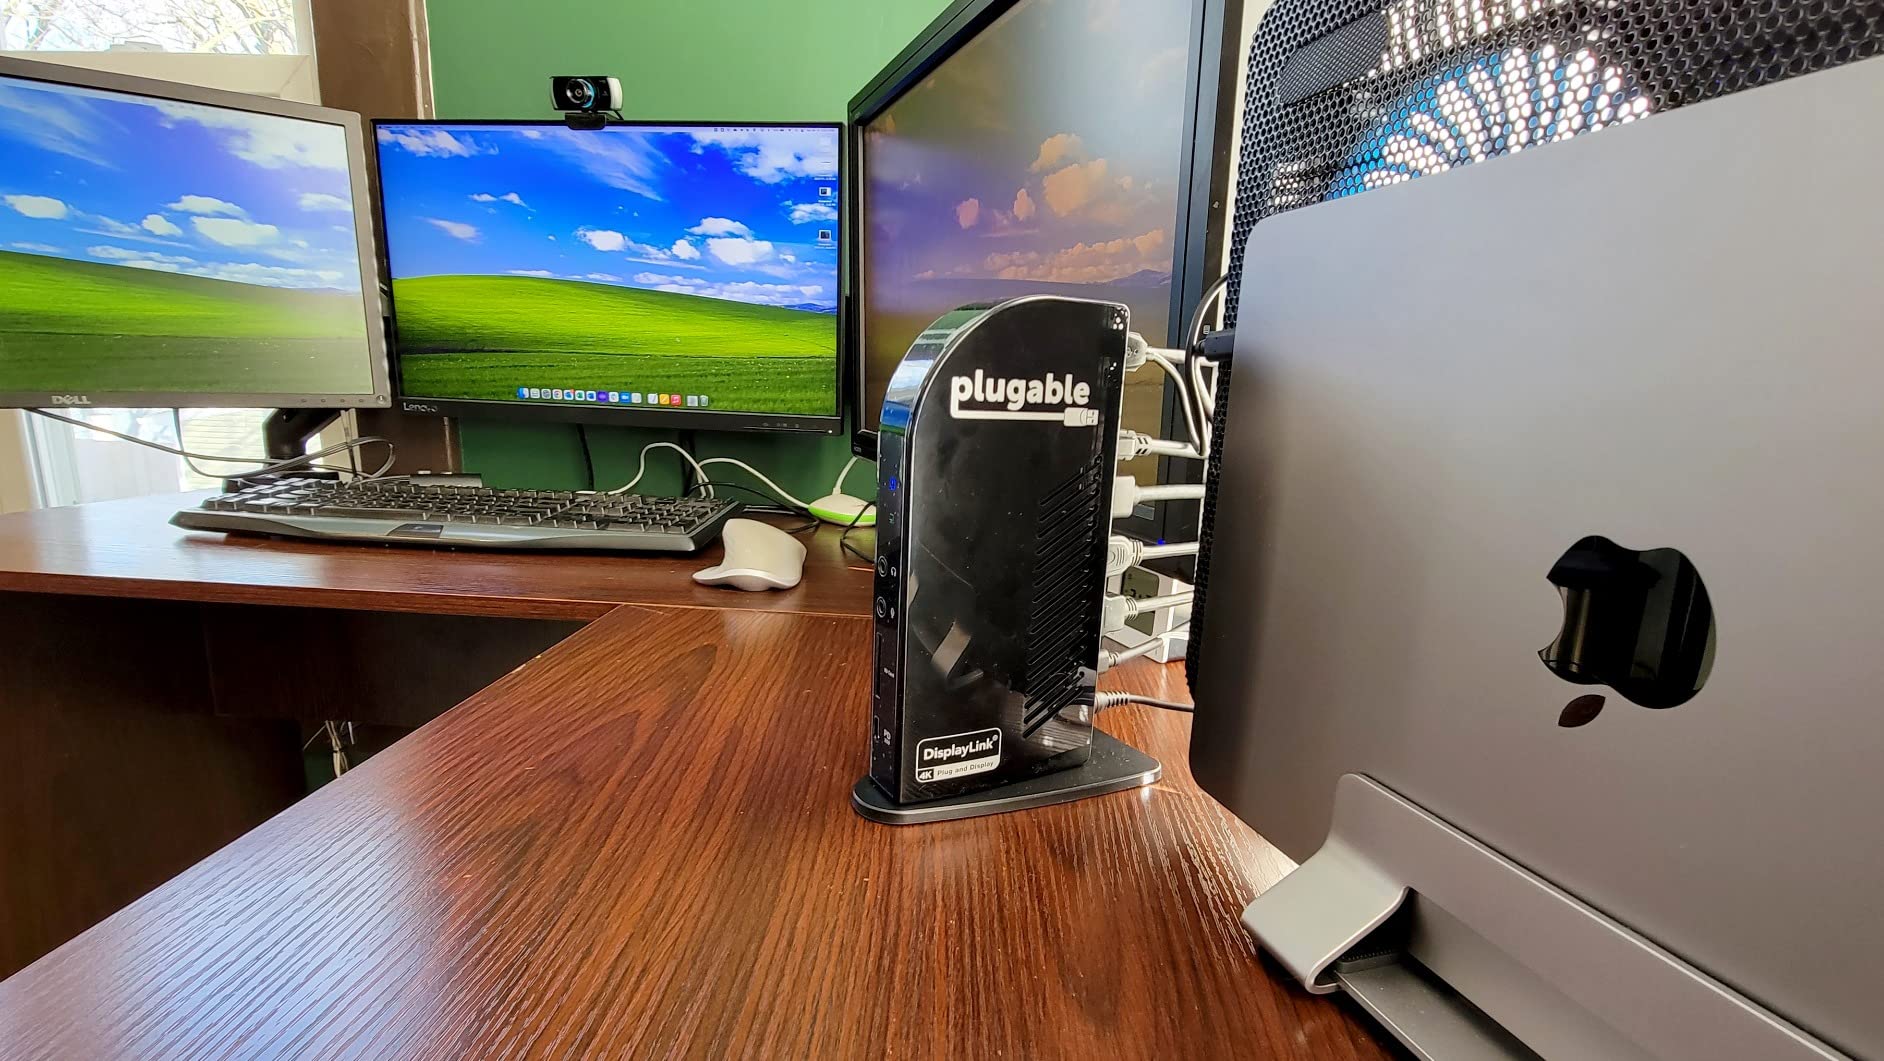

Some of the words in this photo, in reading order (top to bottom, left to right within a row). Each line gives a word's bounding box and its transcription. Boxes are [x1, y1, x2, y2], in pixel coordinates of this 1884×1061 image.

[951, 368, 1091, 411] plugable
[51, 394, 92, 405] DELL
[919, 770, 933, 780] 4K
[969, 761, 994, 771] Display
